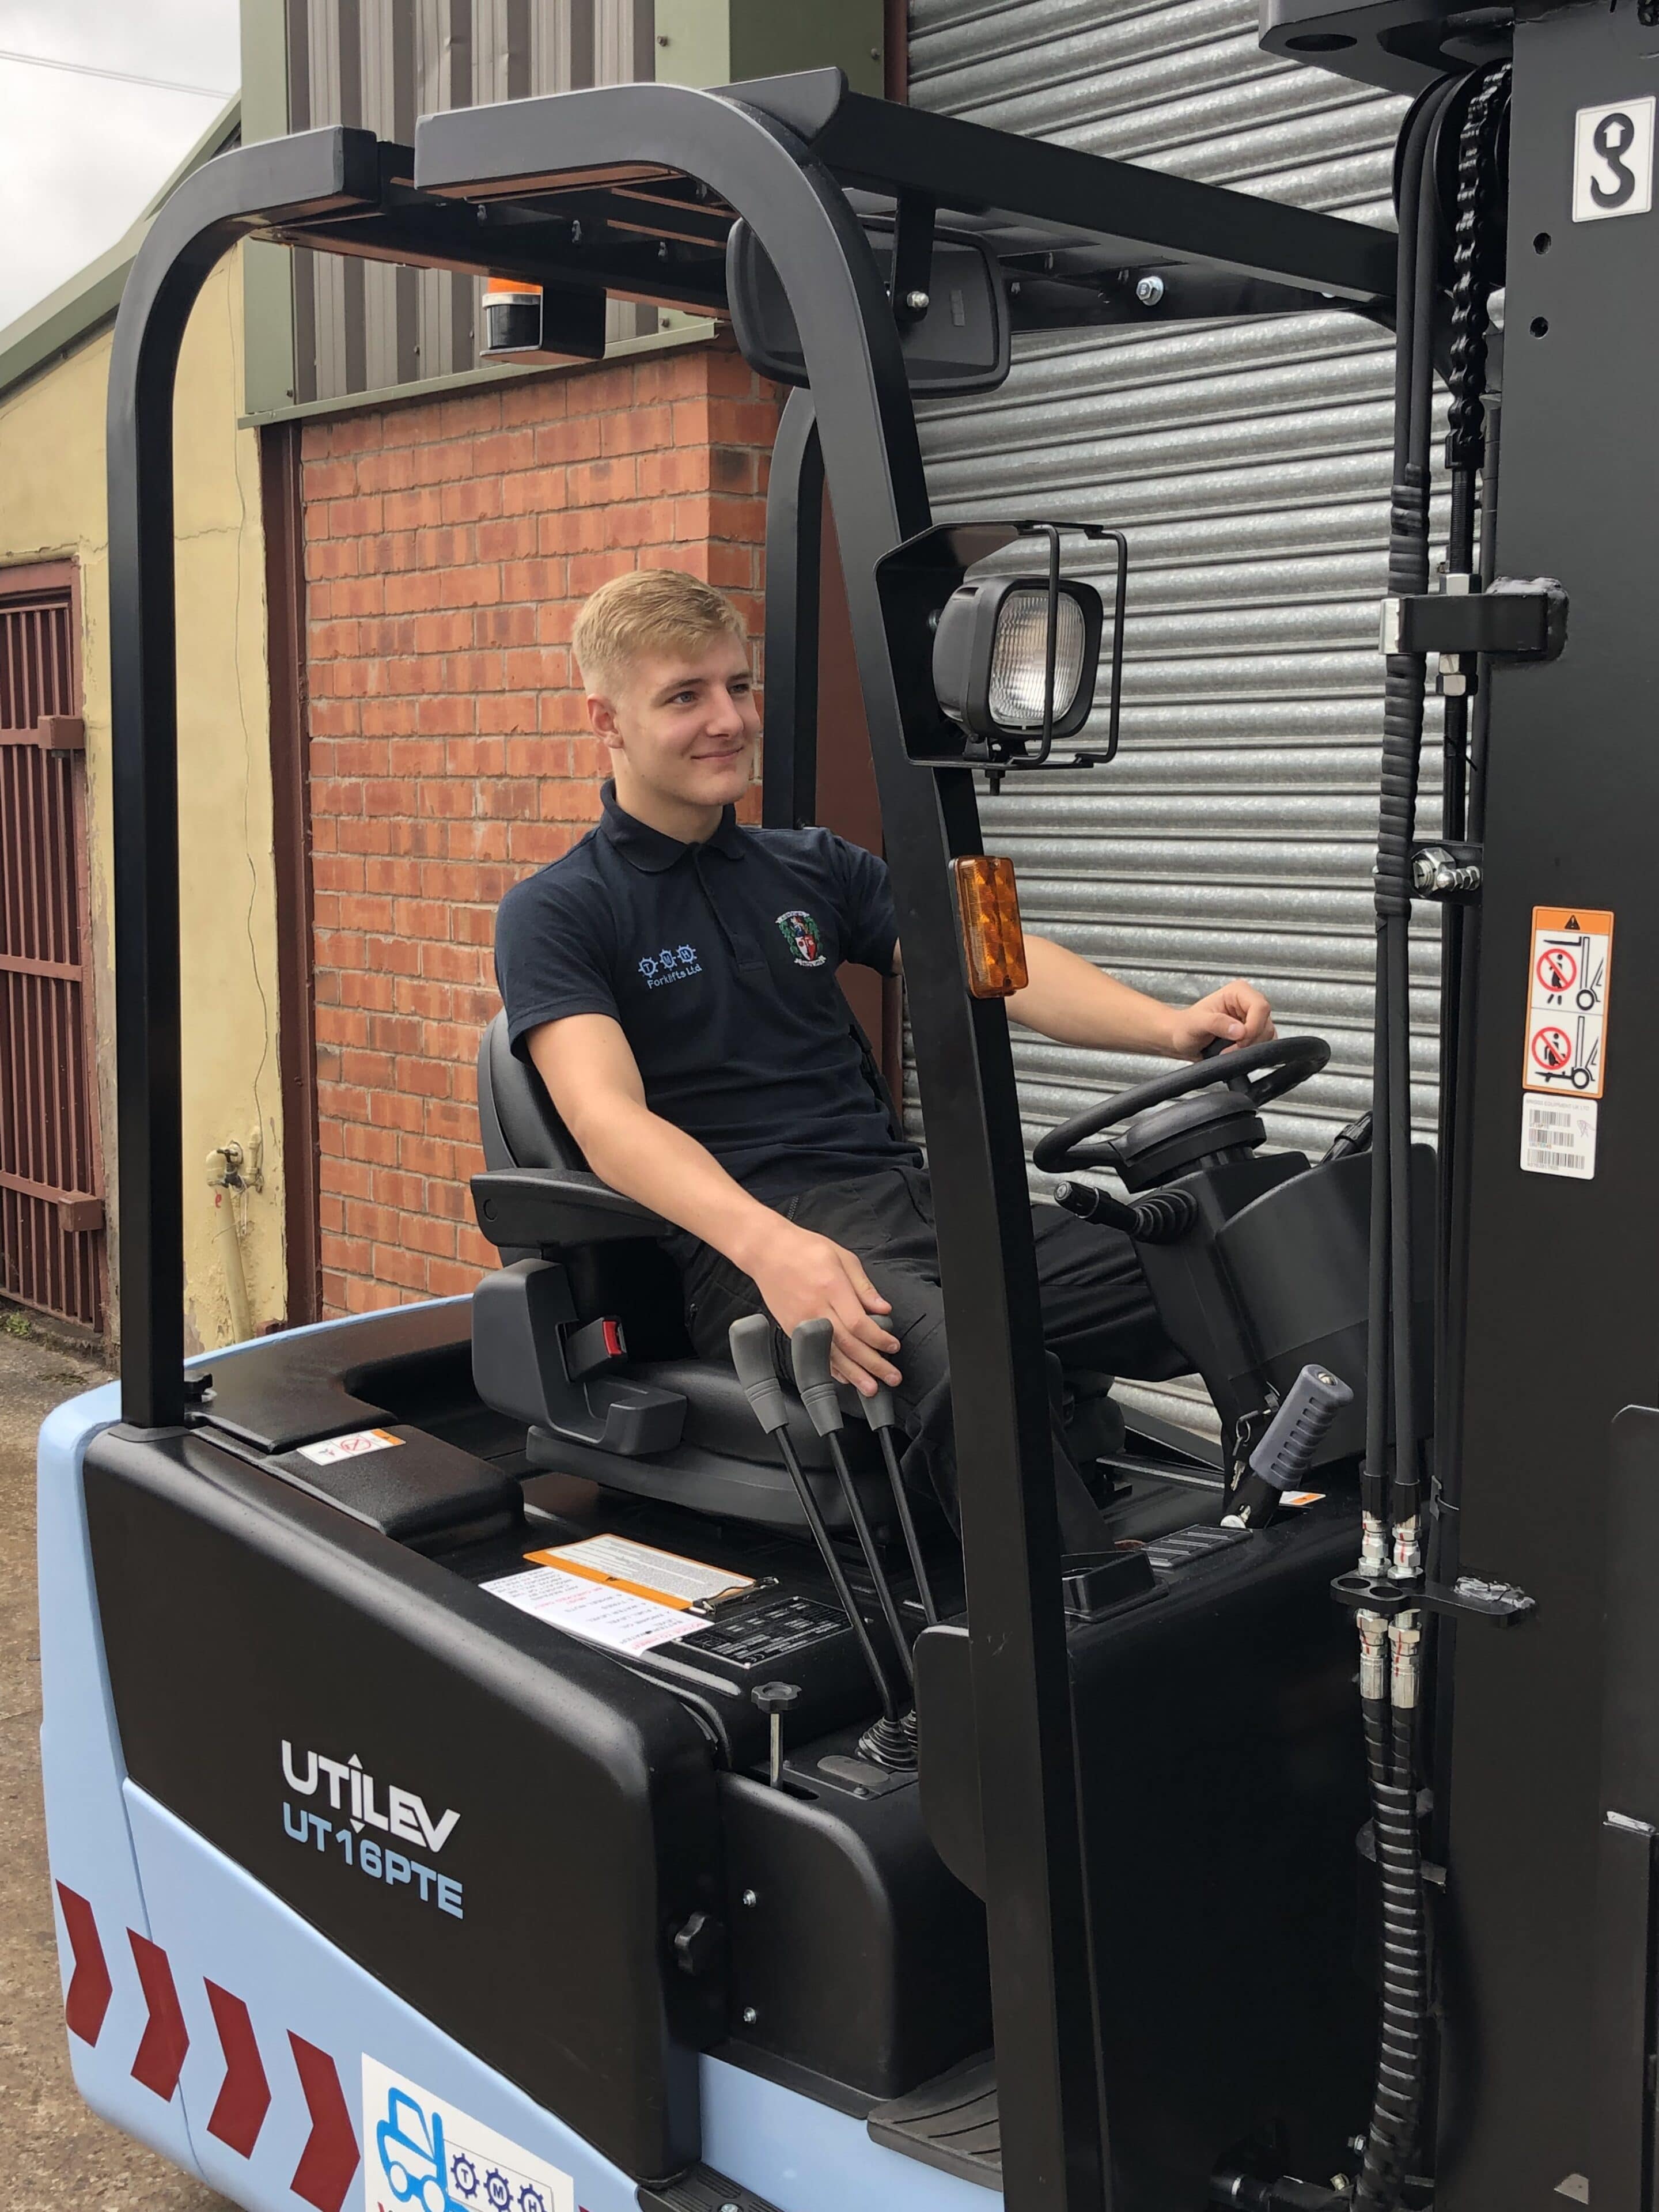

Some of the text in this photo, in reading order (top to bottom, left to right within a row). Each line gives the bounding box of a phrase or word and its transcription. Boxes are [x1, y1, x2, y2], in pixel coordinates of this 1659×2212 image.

[647, 963, 703, 989] Forklifts Ltd
[281, 1739, 461, 1853] UTILEV
[282, 1801, 464, 1919] UT16PTE
[461, 2168, 469, 2183] T
[493, 2183, 504, 2200] M
